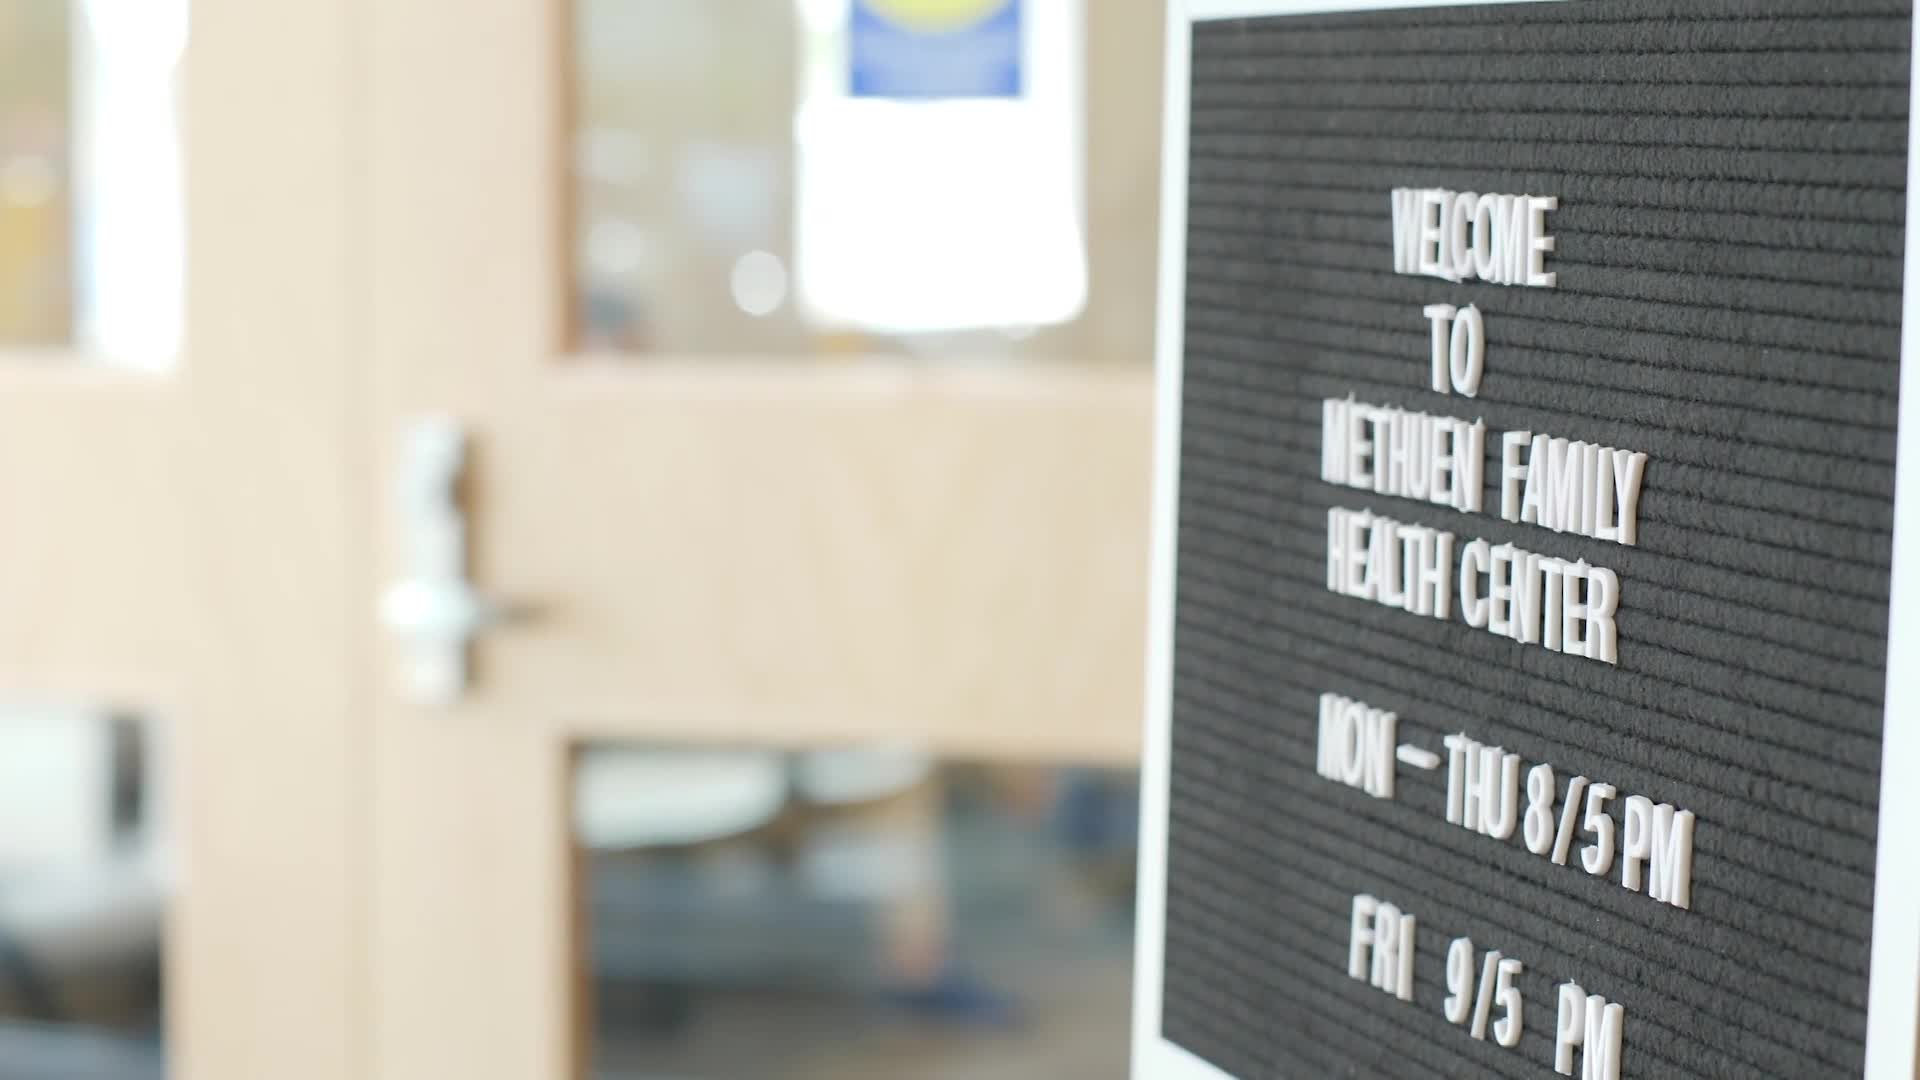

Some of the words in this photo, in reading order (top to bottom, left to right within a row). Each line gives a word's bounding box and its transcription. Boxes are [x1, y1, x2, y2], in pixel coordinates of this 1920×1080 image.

[1391, 187, 1557, 287] WELCOME
[1423, 303, 1484, 397] TO
[1321, 392, 1485, 513] METHUEN
[1501, 431, 1647, 545] FAMILY
[1327, 507, 1454, 618] HEALTH
[1460, 538, 1619, 664] CENTER
[1523, 763, 1616, 875] 8/5
[1622, 795, 1695, 909] PM
[1349, 894, 1415, 1000] FRI
[1444, 937, 1523, 1047] 9/5
[1554, 978, 1624, 1080] PM
